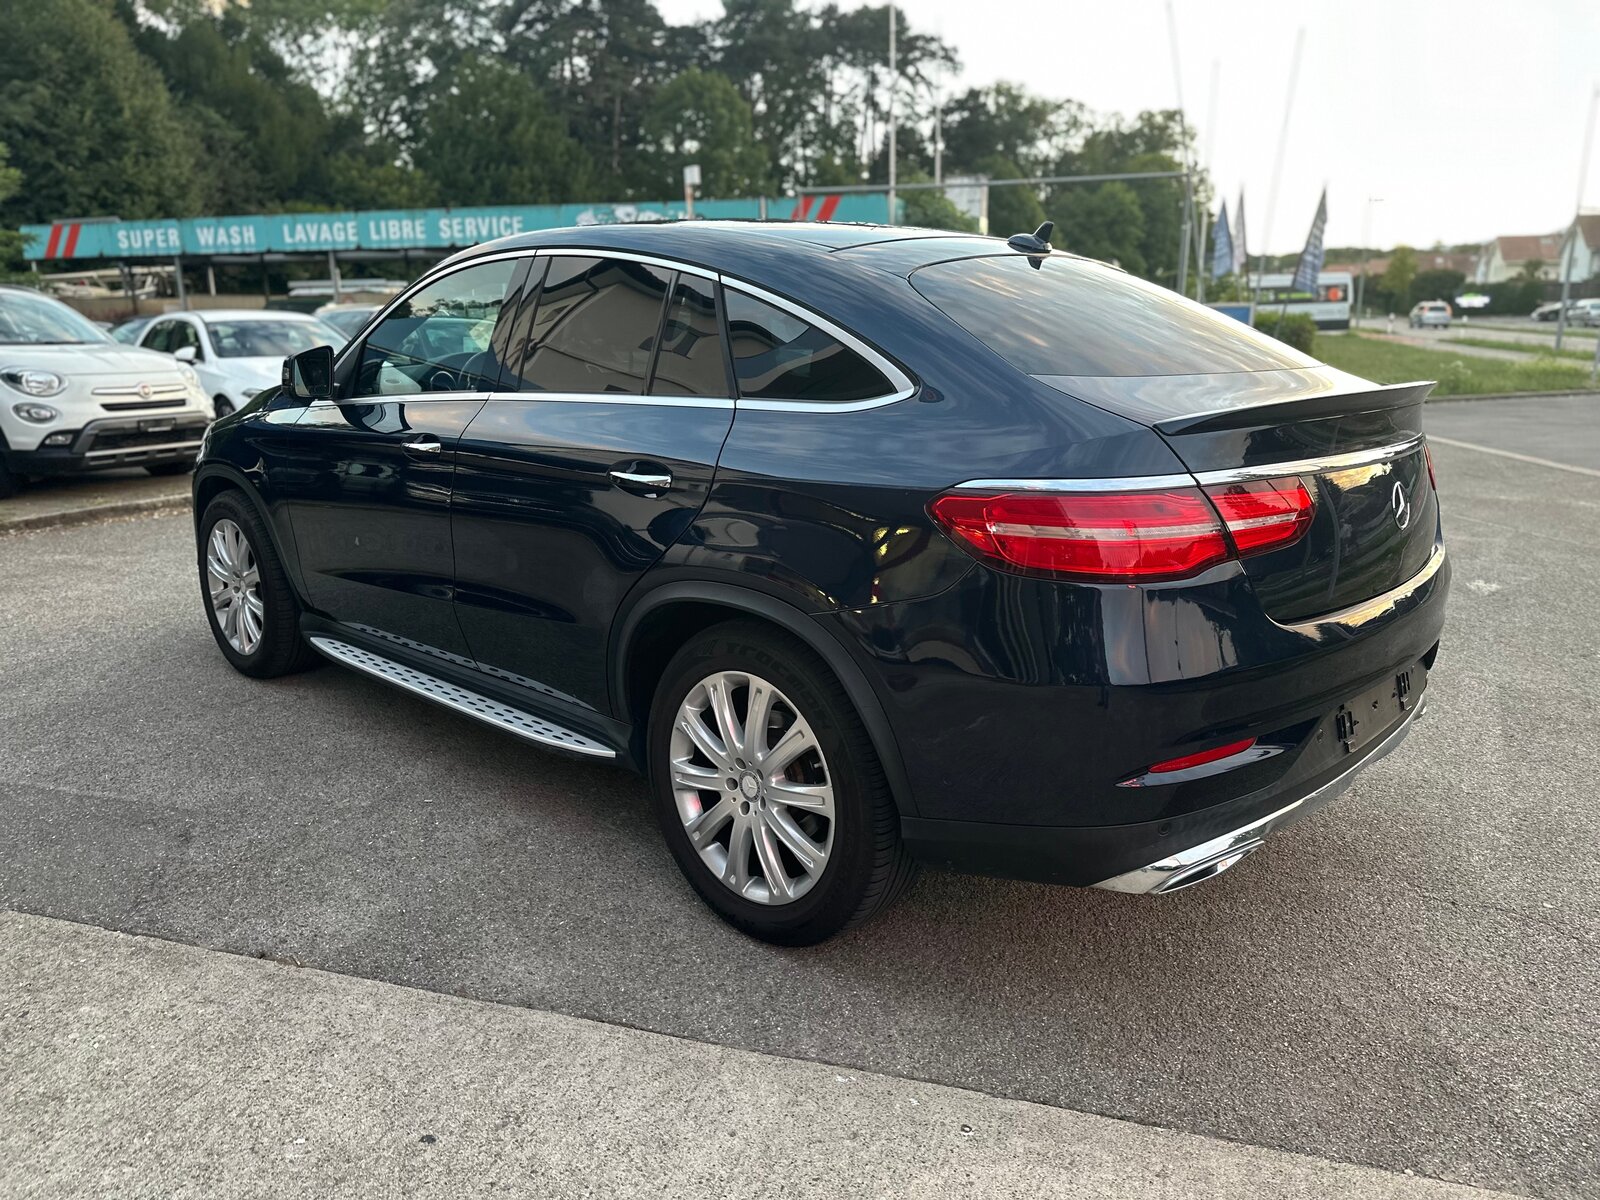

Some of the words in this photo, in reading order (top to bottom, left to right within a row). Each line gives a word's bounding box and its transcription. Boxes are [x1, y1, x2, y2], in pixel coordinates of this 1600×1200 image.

[117, 229, 180, 249] SUPER
[196, 224, 256, 246] WASH
[283, 220, 358, 244] LAVAGE
[369, 219, 426, 241] LIBRE
[438, 215, 524, 239] SERVICE
